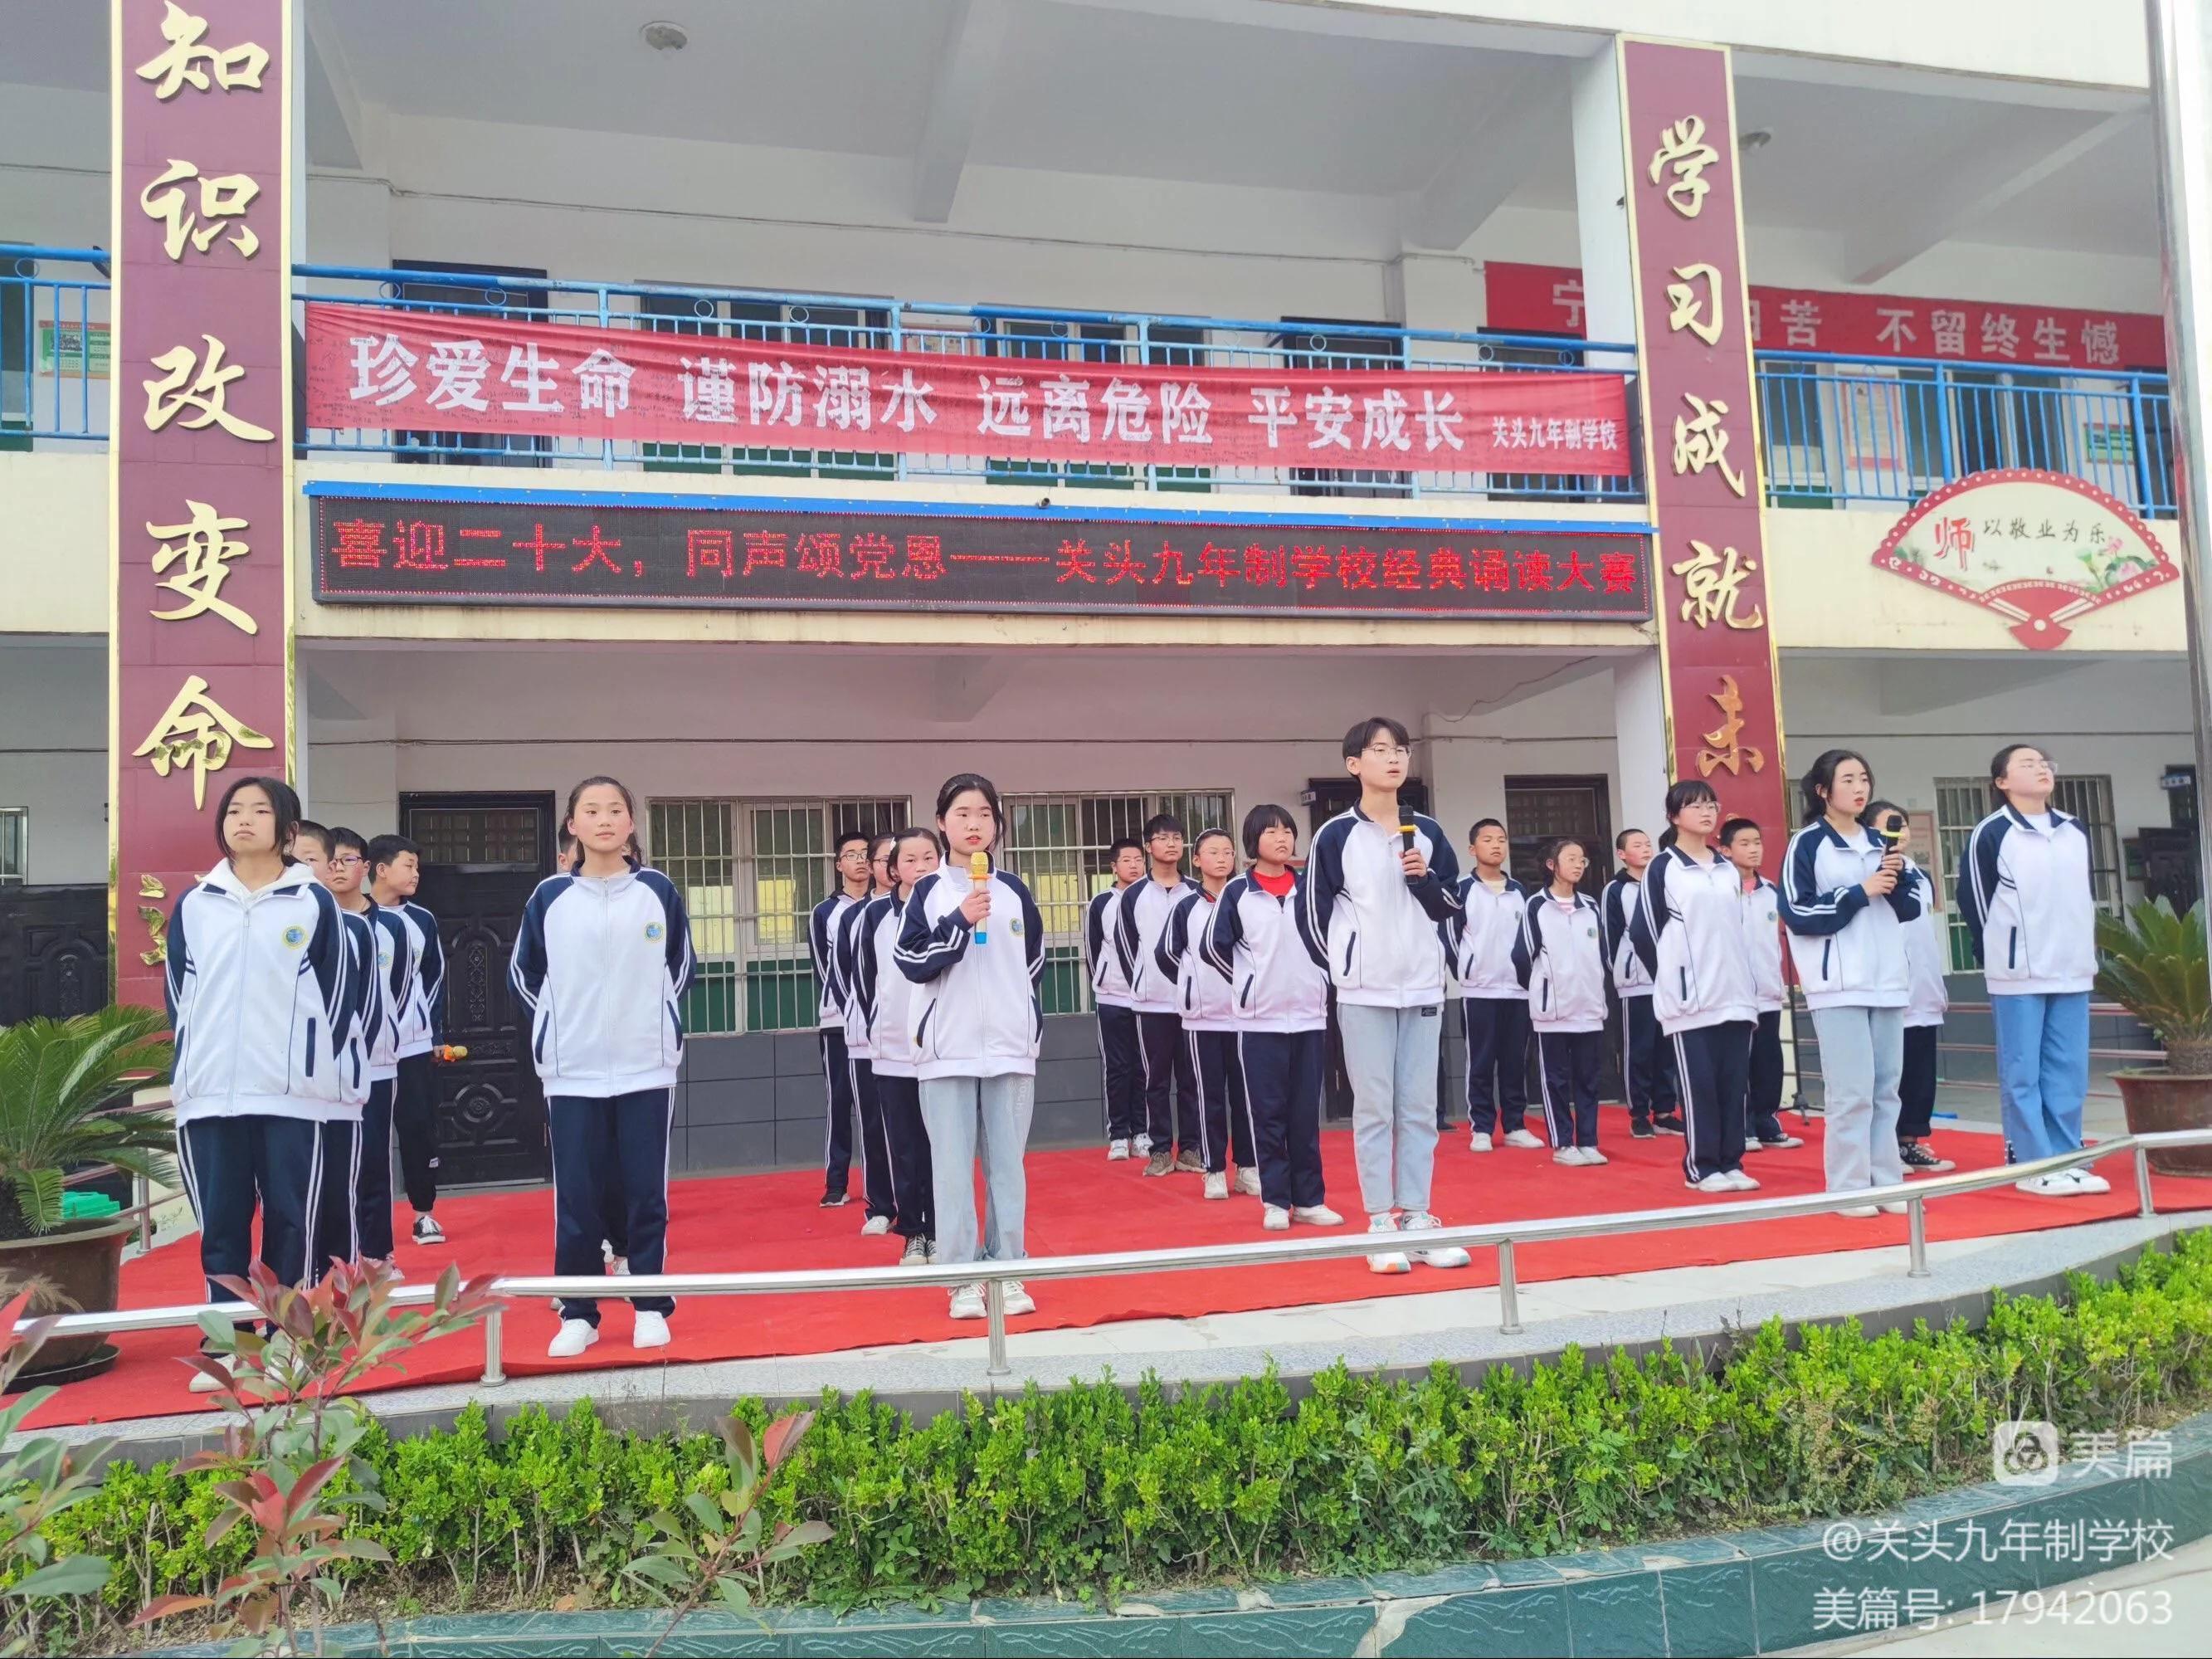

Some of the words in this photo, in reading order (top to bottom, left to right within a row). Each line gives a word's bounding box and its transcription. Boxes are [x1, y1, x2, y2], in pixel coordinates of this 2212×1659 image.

[349, 334, 636, 418] 珍爱生命
[677, 357, 938, 433] 谨防溺水
[976, 373, 1213, 444] 远离危险
[1247, 386, 1465, 452] 平安成长
[1493, 417, 1618, 451] 关头九年制学校
[1876, 308, 2119, 364] 不留终生憾
[135, 2, 277, 966] 知识改变命
[1647, 115, 1765, 822] 学习成就未
[1932, 516, 1975, 571] 师
